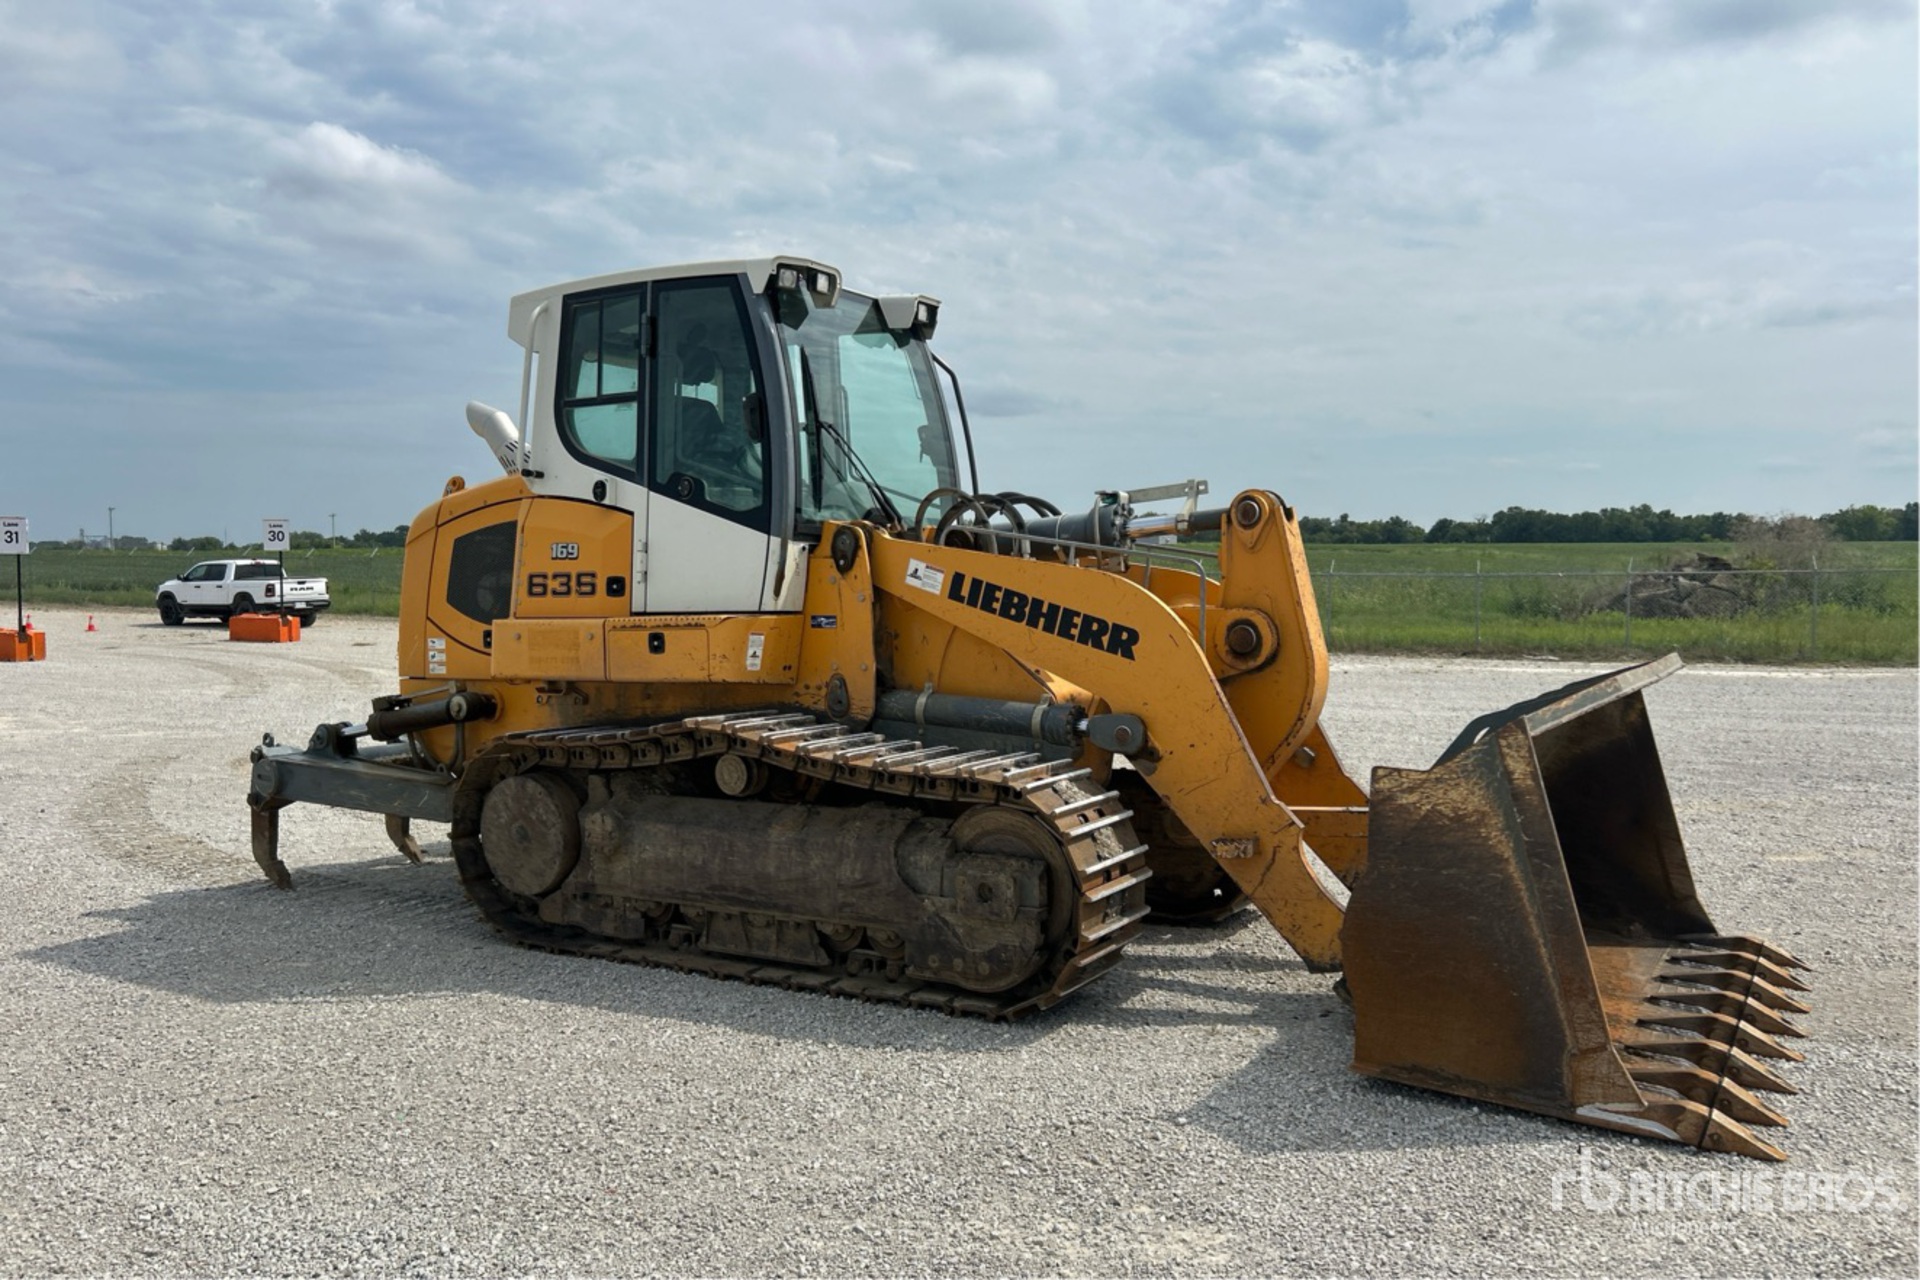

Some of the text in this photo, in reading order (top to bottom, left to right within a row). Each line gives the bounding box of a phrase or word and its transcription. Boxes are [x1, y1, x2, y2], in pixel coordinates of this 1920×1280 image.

[4, 530, 19, 544] 31
[268, 530, 285, 542] 30
[550, 542, 579, 560] 169
[526, 570, 598, 598] 635
[947, 571, 1140, 661] LIEBHERR
